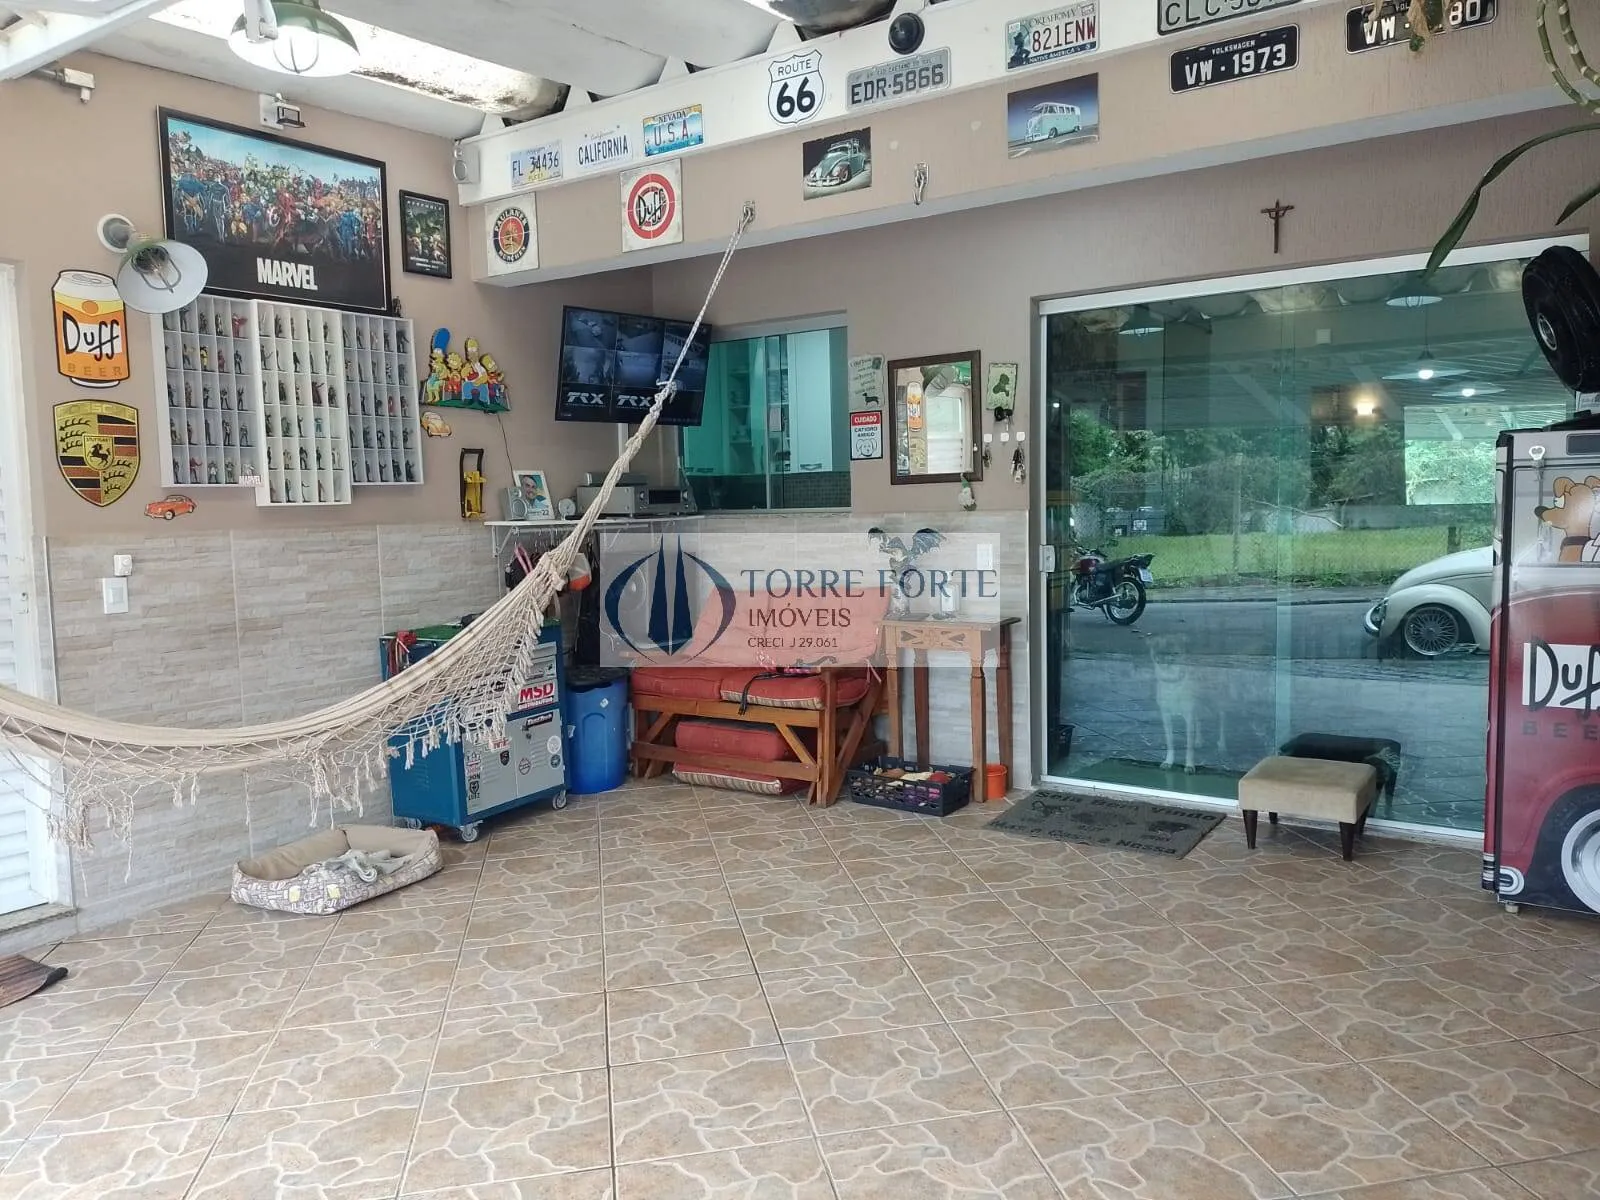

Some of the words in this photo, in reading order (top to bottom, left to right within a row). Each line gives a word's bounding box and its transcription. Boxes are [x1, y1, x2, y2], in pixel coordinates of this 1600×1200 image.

[1032, 15, 1097, 53] 821ENW
[1212, 40, 1256, 55] VOLKSWAGEN
[777, 58, 812, 77] ROUTE
[1185, 59, 1213, 86] VW
[1232, 43, 1287, 75] 1973
[776, 76, 816, 118] 66
[658, 110, 687, 123] NEVADA
[512, 159, 524, 179] FL
[529, 151, 560, 174] 34436
[578, 134, 629, 166] CALIFORNIA
[637, 187, 667, 229] Duff
[256, 257, 318, 291] MARVEL
[62, 310, 120, 361] Duff
[67, 363, 122, 376] BEER
[519, 683, 553, 702] MSD
[1523, 721, 1600, 740] BEE
